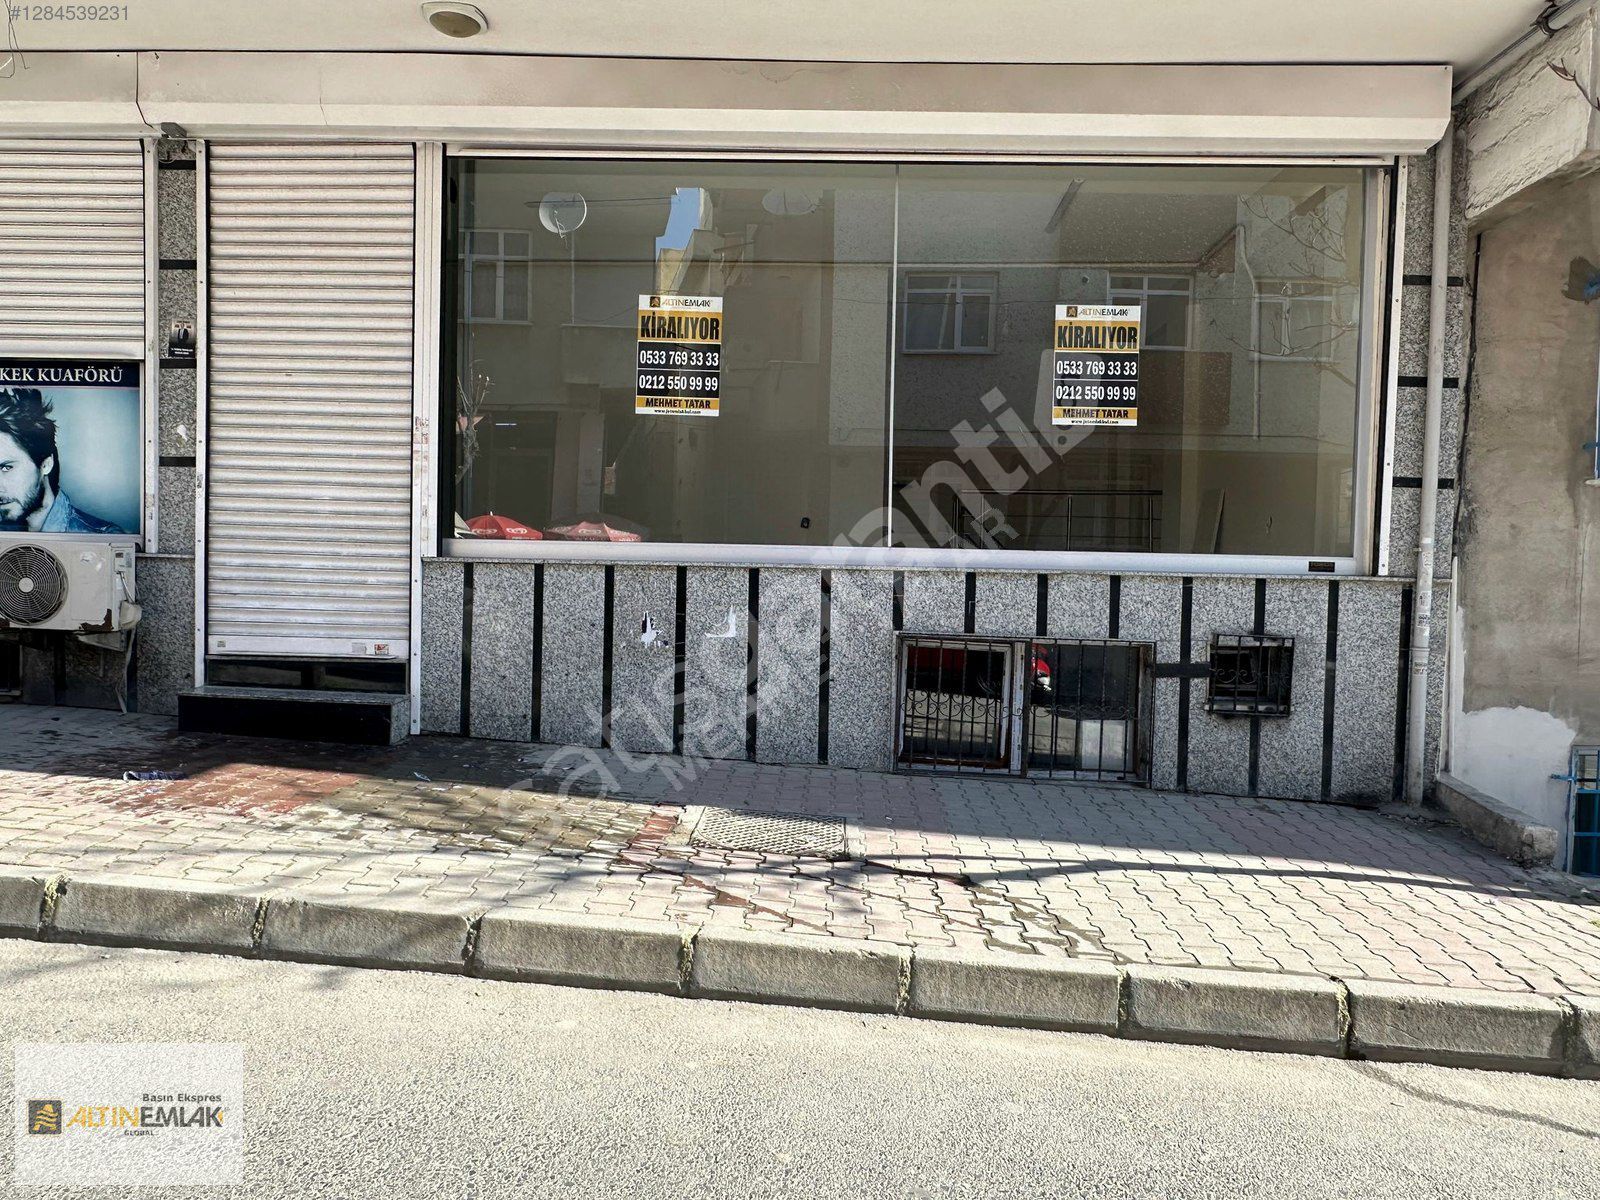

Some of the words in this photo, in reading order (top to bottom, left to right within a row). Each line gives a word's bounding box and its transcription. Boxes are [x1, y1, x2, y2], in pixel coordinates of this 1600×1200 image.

[640, 312, 720, 340] KİRALIYOR
[1057, 322, 1137, 349] KİRALIYOR
[640, 350, 666, 365] 0533
[669, 351, 688, 365] 769
[690, 352, 703, 366] 33
[706, 352, 719, 366] 33
[37, 366, 123, 383] KUAFÖRÜ
[1056, 360, 1083, 375] 0533
[1086, 361, 1105, 375] 769
[1108, 361, 1121, 375] 33
[1123, 362, 1137, 376] 33
[639, 375, 665, 389] 0212
[668, 376, 687, 390] 550
[689, 376, 703, 391] 99
[705, 377, 718, 391] 99
[1055, 385, 1082, 399] 0212
[1085, 386, 1104, 400] 550
[1106, 386, 1120, 400] 99
[1122, 386, 1136, 400] 99
[645, 397, 682, 408] MEHMET
[684, 399, 711, 409] TATAR
[1062, 408, 1099, 418] MEHMET
[1102, 409, 1129, 418] TATAR
